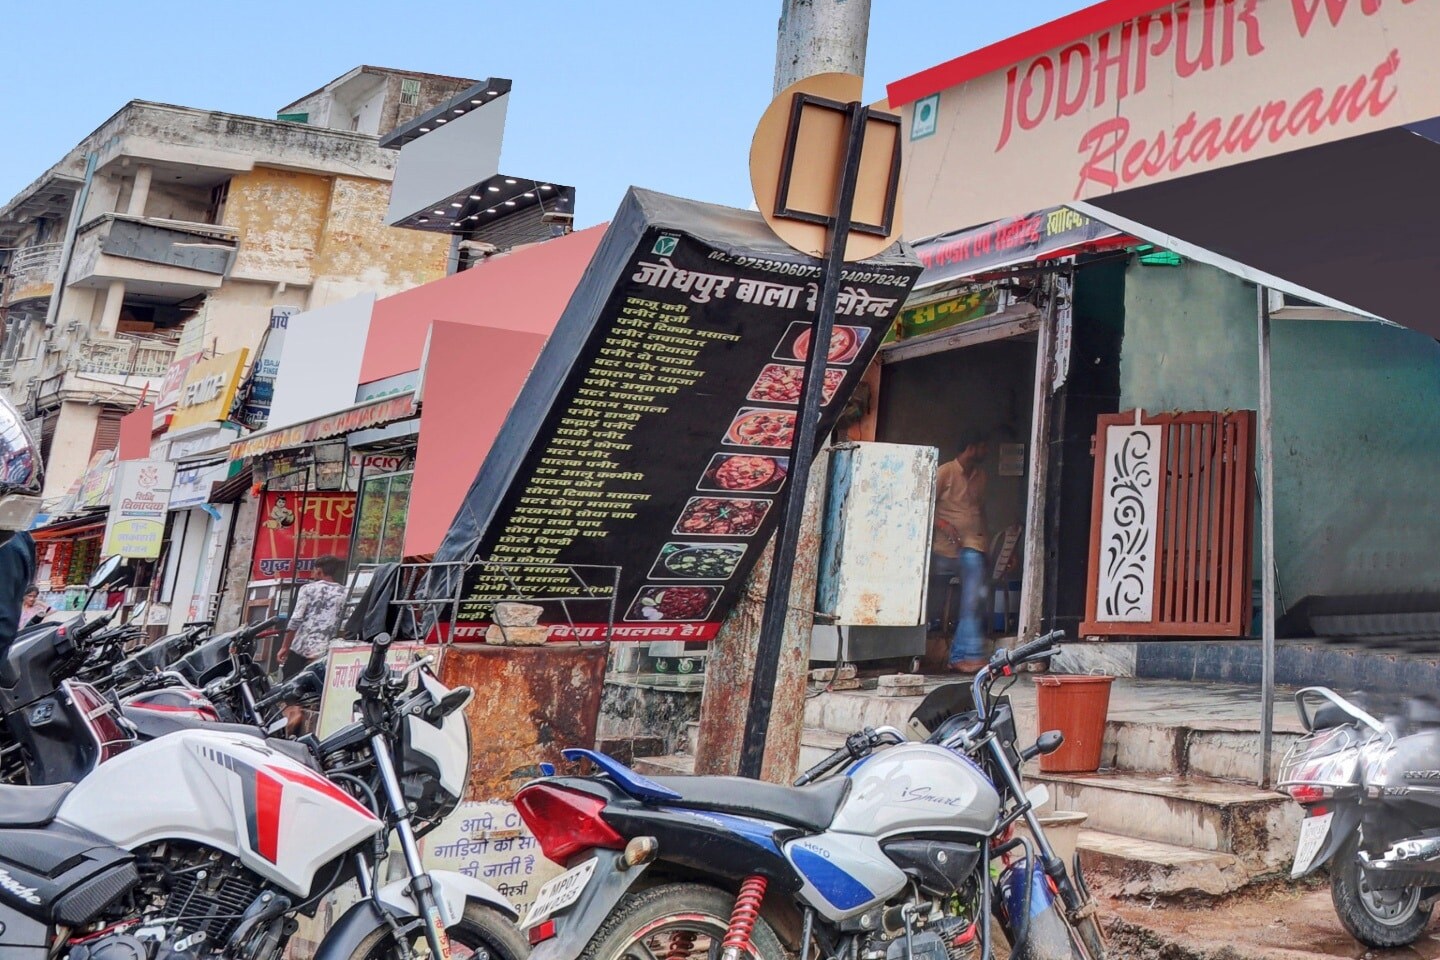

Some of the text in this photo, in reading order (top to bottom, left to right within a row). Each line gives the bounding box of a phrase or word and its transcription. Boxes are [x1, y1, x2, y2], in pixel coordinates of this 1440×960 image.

[1073, 48, 1401, 200] Restaurant
[631, 257, 734, 305] जोधपुर
[806, 282, 897, 318] रेटोरेन्ट
[623, 307, 657, 318] पनीर
[617, 317, 653, 328] पनीर
[611, 327, 648, 338] पनीर
[606, 337, 641, 349] पनीर
[600, 347, 635, 359] पनीर
[625, 361, 659, 372] पनीर
[584, 378, 619, 388] पनीर
[568, 407, 602, 417] पनीर
[603, 421, 637, 431] पनीर
[592, 430, 626, 440] पनीर
[578, 450, 612, 459] पनीर
[352, 456, 403, 468] LUCKY
[586, 460, 620, 469] पनीर
[121, 498, 165, 511] विनायक
[483, 856, 520, 877] जाती
[524, 855, 535, 874] है
